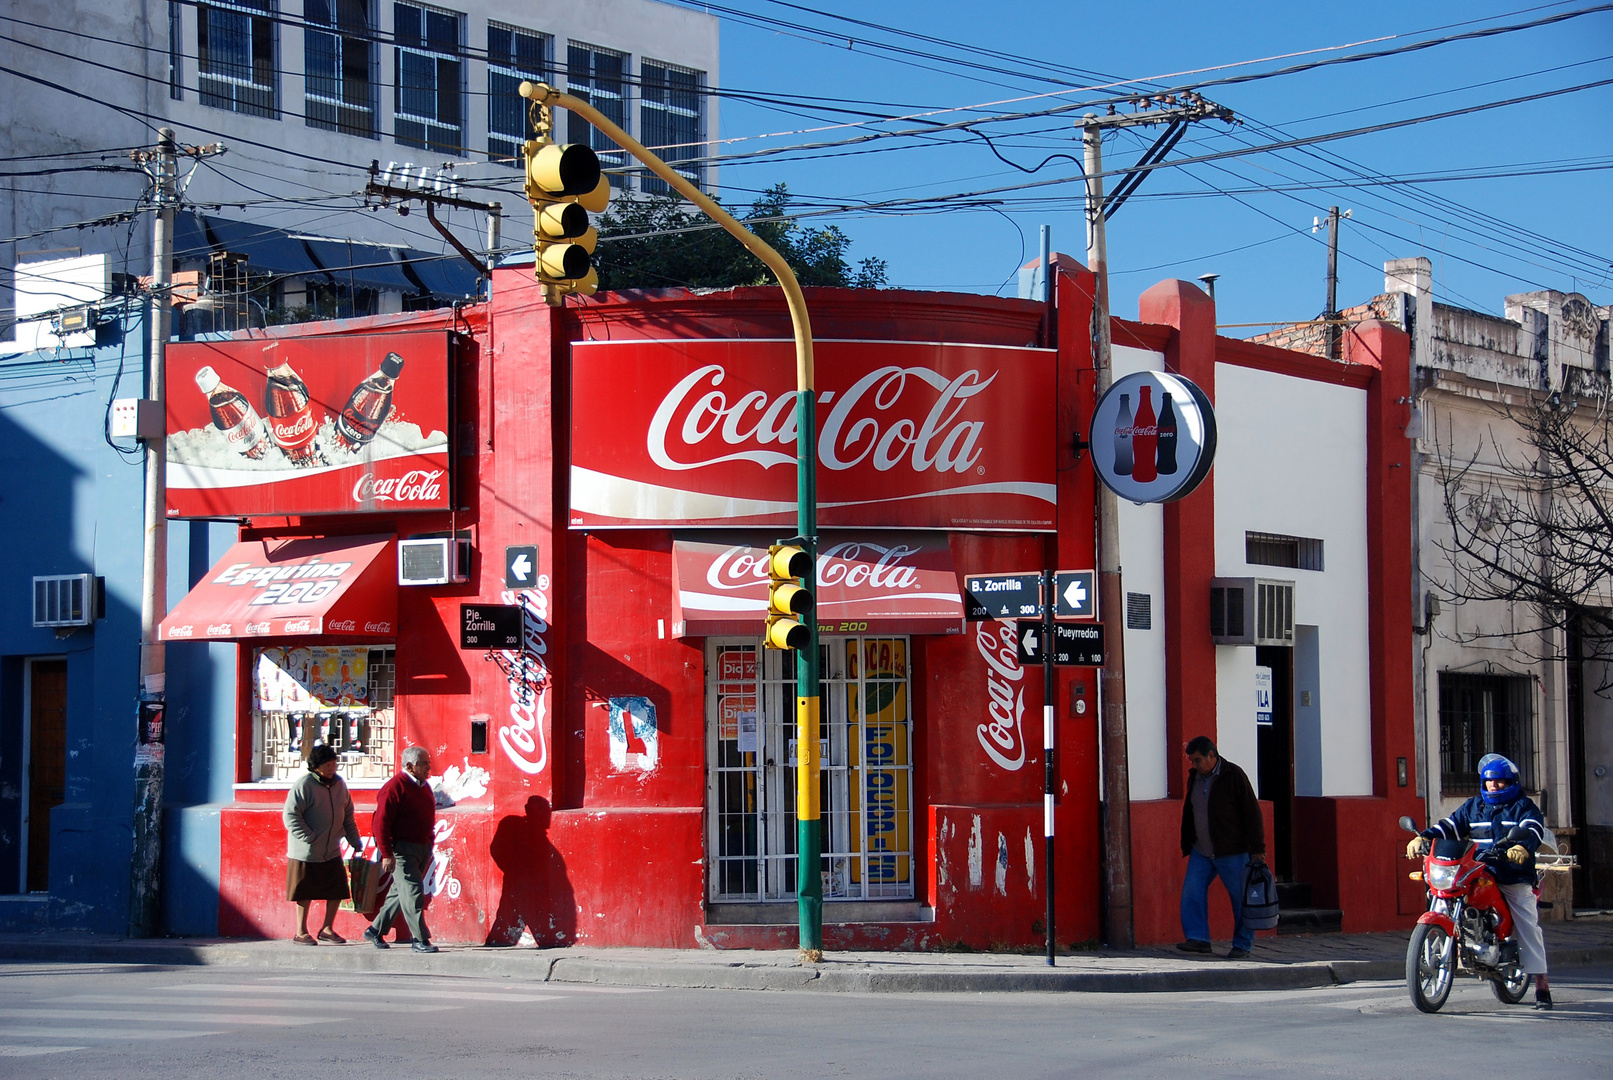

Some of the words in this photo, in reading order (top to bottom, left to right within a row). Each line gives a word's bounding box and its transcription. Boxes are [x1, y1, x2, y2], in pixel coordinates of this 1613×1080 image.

[647, 364, 999, 473] Coca-Cola
[352, 469, 444, 503] Coca-Cola
[706, 542, 923, 589] CocCola
[210, 558, 355, 588] Esquina
[971, 580, 983, 592] B.
[984, 578, 1022, 592] Zorrilla
[249, 579, 342, 607] 200
[466, 609, 482, 622] Pje.
[972, 606, 988, 616] 200
[1020, 604, 1036, 615] 300
[328, 619, 356, 631] Coca-Cola
[364, 621, 391, 633] Coca-Cola
[465, 620, 496, 631] Zorrilla
[838, 621, 868, 631] 200
[1057, 626, 1099, 640] Pueyrredón
[466, 636, 478, 644] 300
[506, 636, 518, 644] 200
[1058, 653, 1069, 662] 200
[1091, 654, 1102, 662] 100
[976, 620, 1026, 771] Coca-Co
